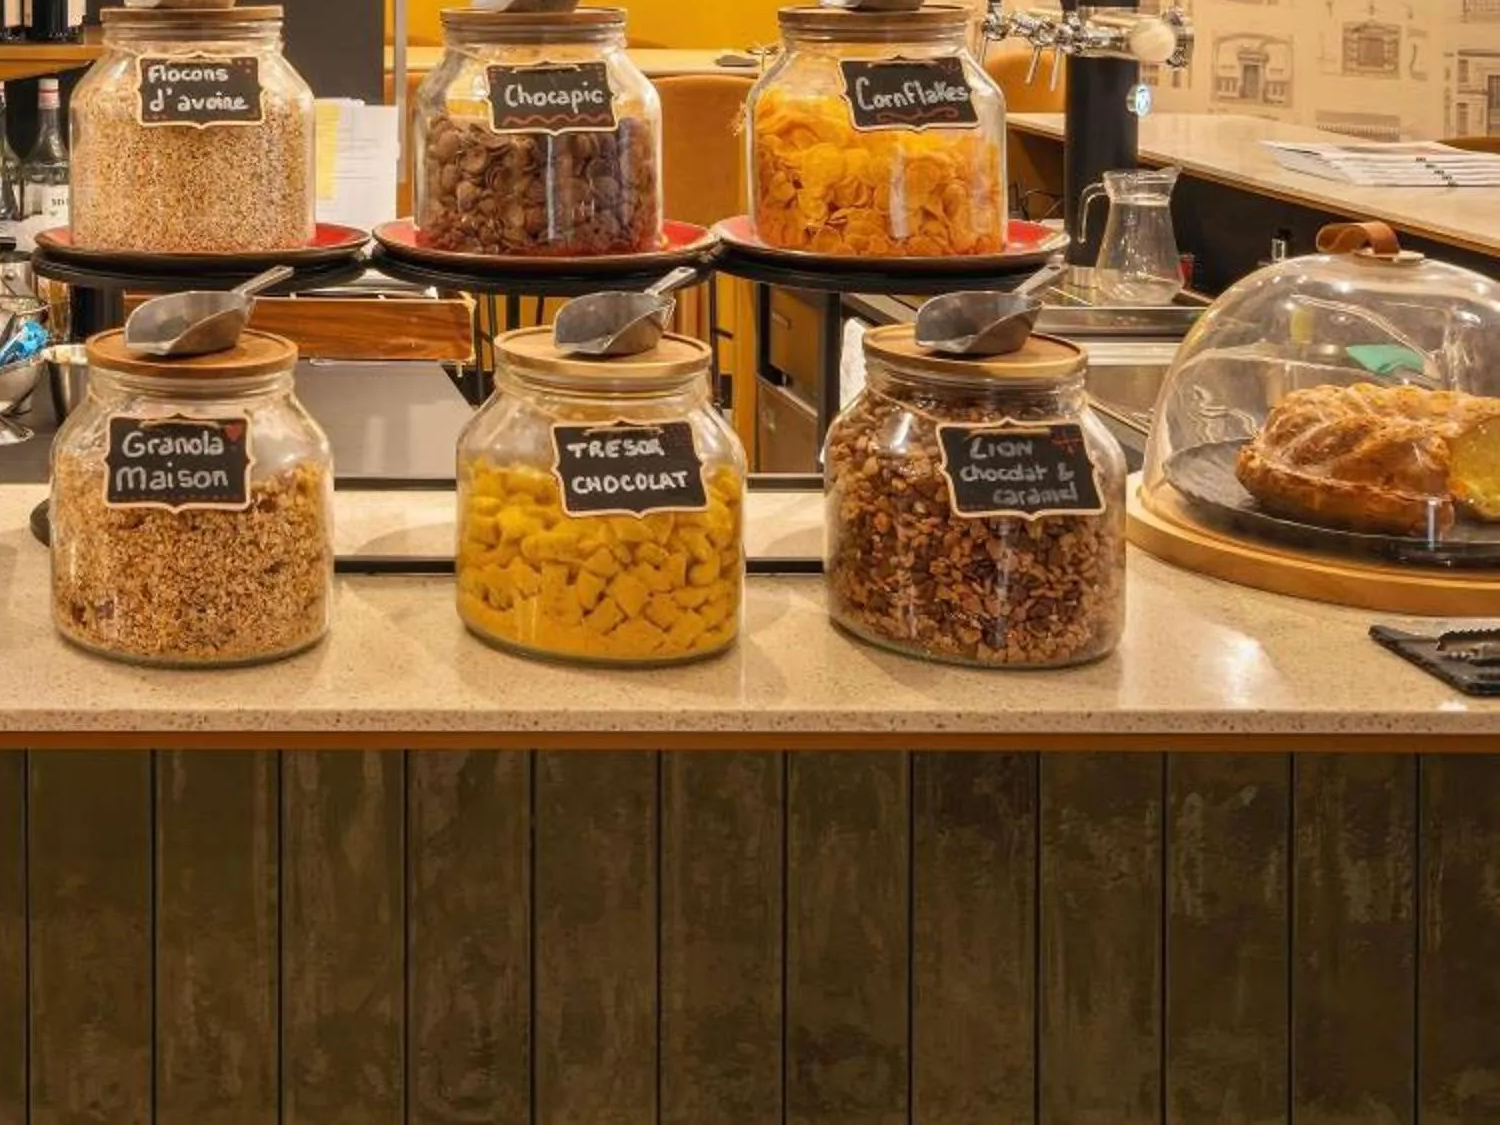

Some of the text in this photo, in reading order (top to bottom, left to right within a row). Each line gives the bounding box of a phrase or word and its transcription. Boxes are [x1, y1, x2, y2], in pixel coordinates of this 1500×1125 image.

[503, 80, 604, 114] Chocapic
[121, 430, 225, 458] Granola
[566, 437, 666, 459] TRESOR
[571, 470, 689, 495] CHOCOLAT
